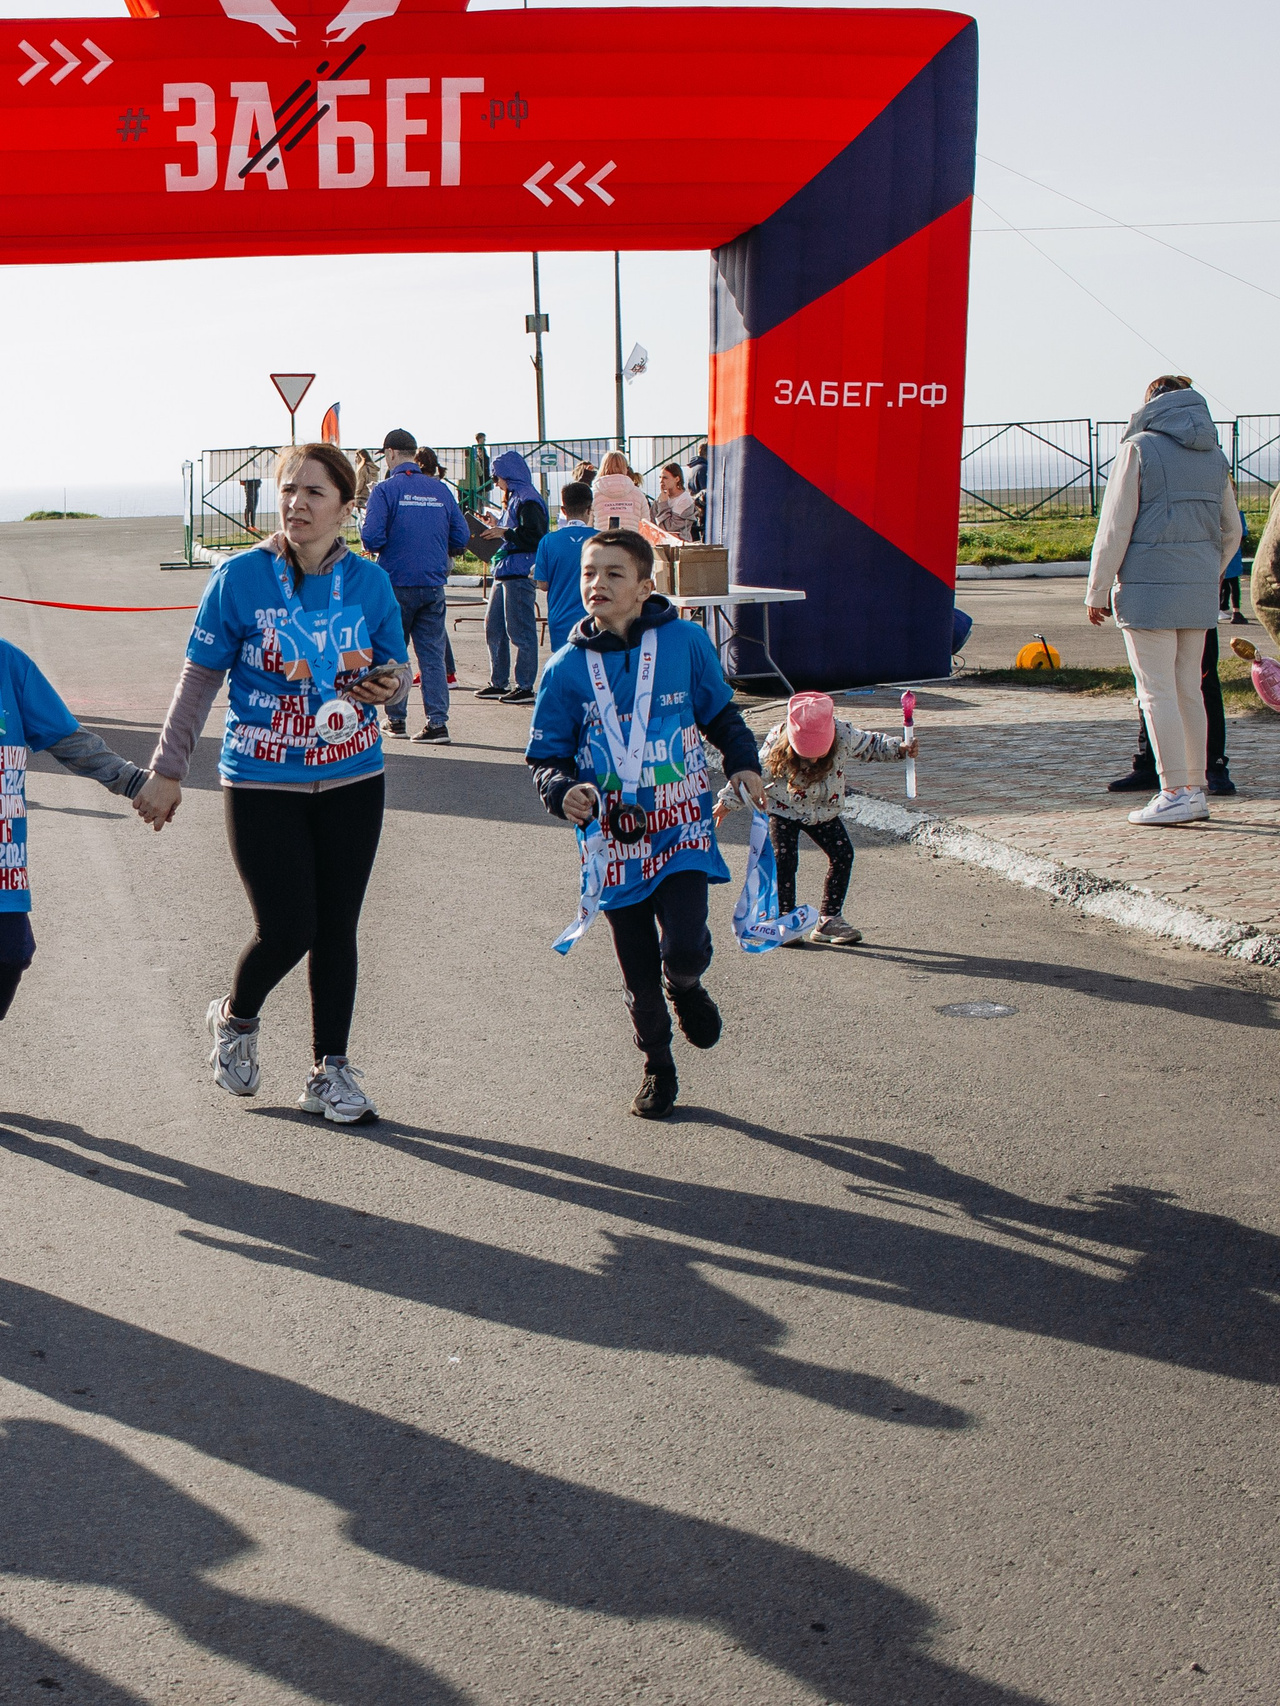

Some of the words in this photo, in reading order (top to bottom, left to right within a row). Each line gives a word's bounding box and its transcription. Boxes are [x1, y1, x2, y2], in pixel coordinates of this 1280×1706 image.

[774, 379, 947, 408] ЗАБЕГ.РФ
[592, 663, 601, 680] ПСБ
[642, 663, 650, 680] ПСБ
[607, 834, 652, 862] БОВЬ
[760, 926, 776, 936] ПСБ
